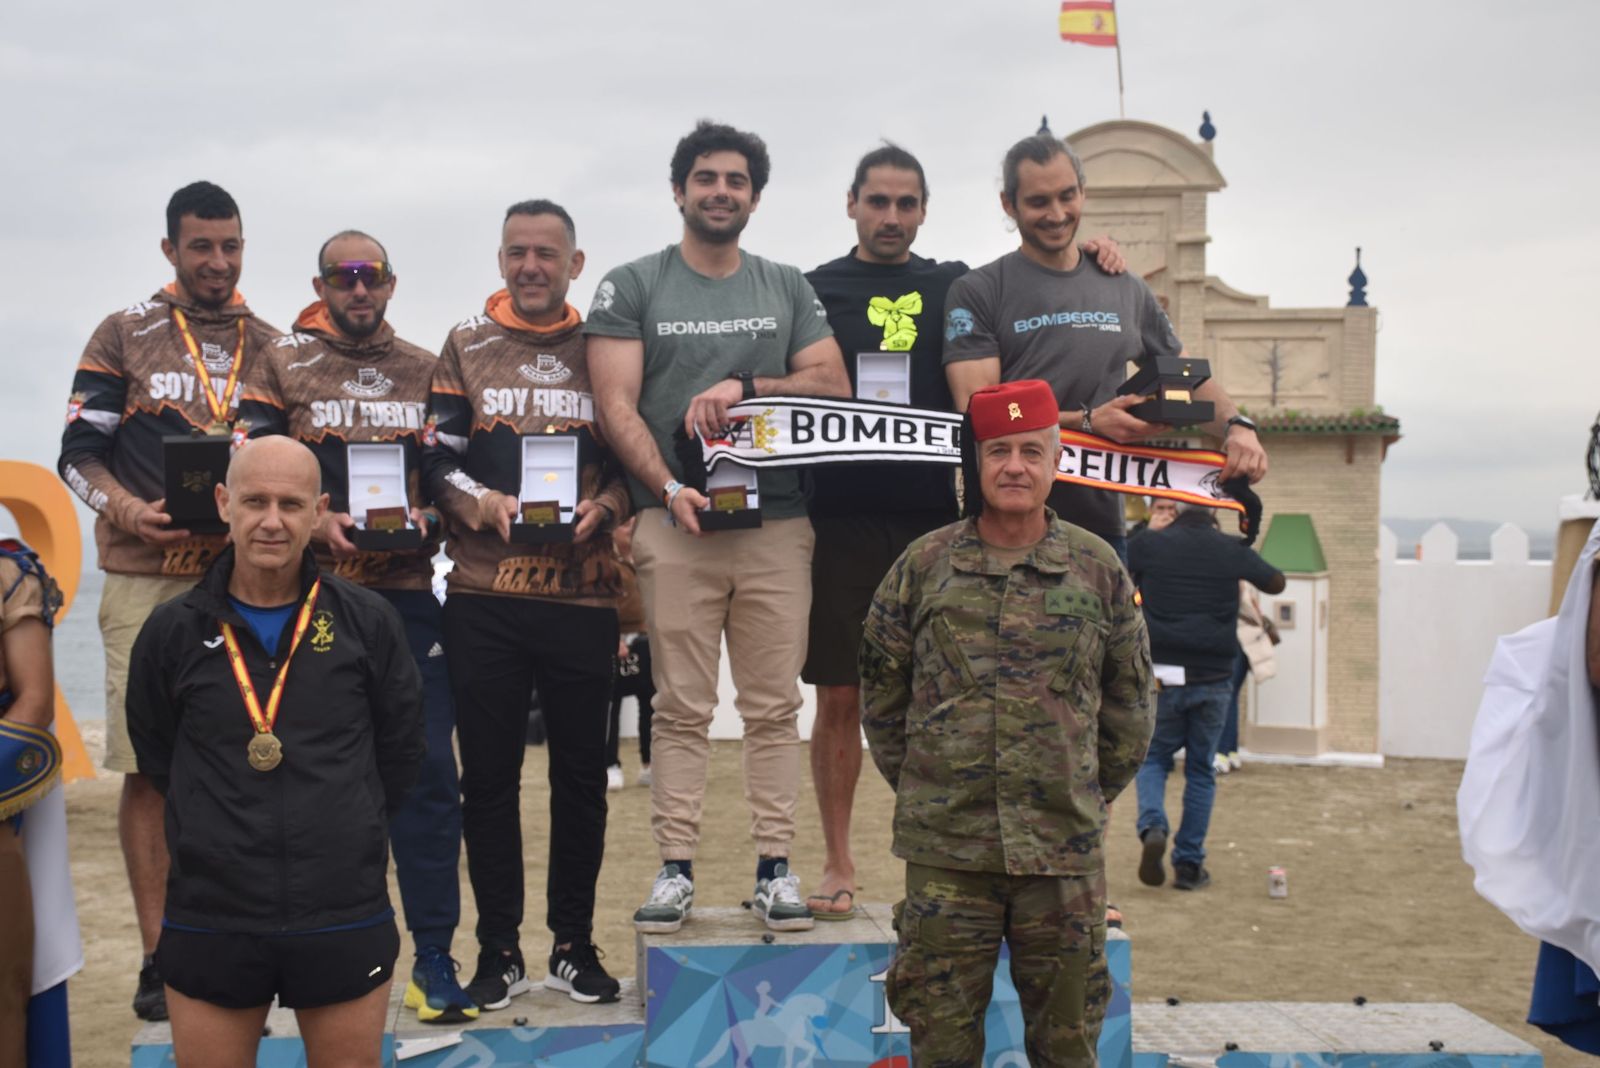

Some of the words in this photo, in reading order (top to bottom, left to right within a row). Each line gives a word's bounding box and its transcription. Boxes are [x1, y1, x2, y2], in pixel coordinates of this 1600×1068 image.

[656, 317, 777, 336] BOMBEROS
[1013, 311, 1119, 333] BOMBEROS
[149, 372, 195, 402] SOY
[310, 399, 356, 428] SOY
[482, 387, 529, 417] SOY
